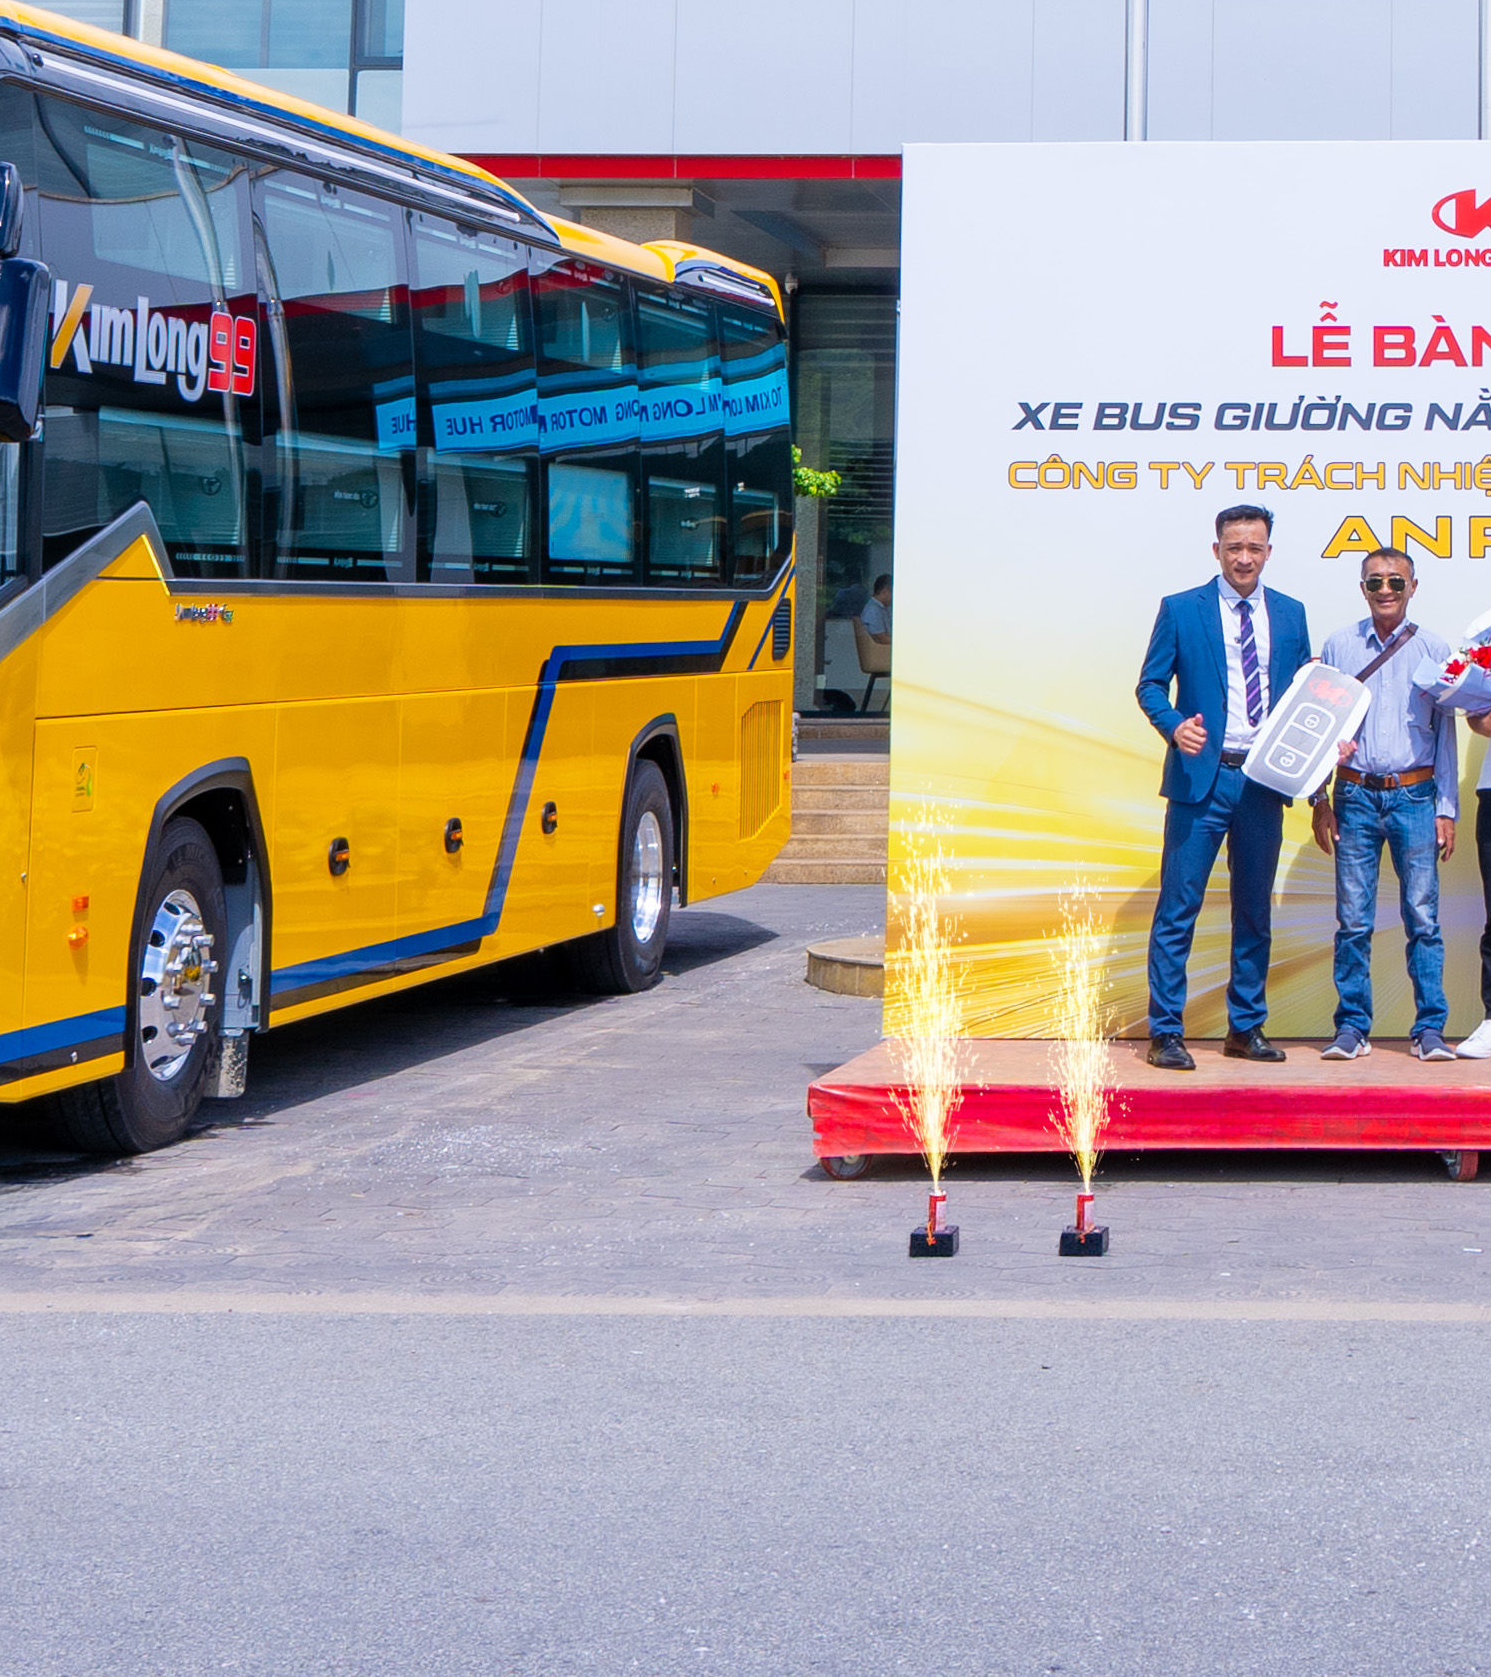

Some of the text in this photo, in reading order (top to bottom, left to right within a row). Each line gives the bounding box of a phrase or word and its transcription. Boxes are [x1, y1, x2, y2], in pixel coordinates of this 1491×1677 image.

[1383, 248, 1428, 267] KIM
[1272, 301, 1351, 367] LỄ
[1011, 402, 1083, 431] XE
[1093, 402, 1202, 431] BUS
[1213, 395, 1413, 431] GIƯỜNG
[1008, 454, 1138, 490] CÔNG
[1149, 461, 1215, 490] TY
[1225, 454, 1386, 490] TRÁCH
[1321, 515, 1452, 558] AN
